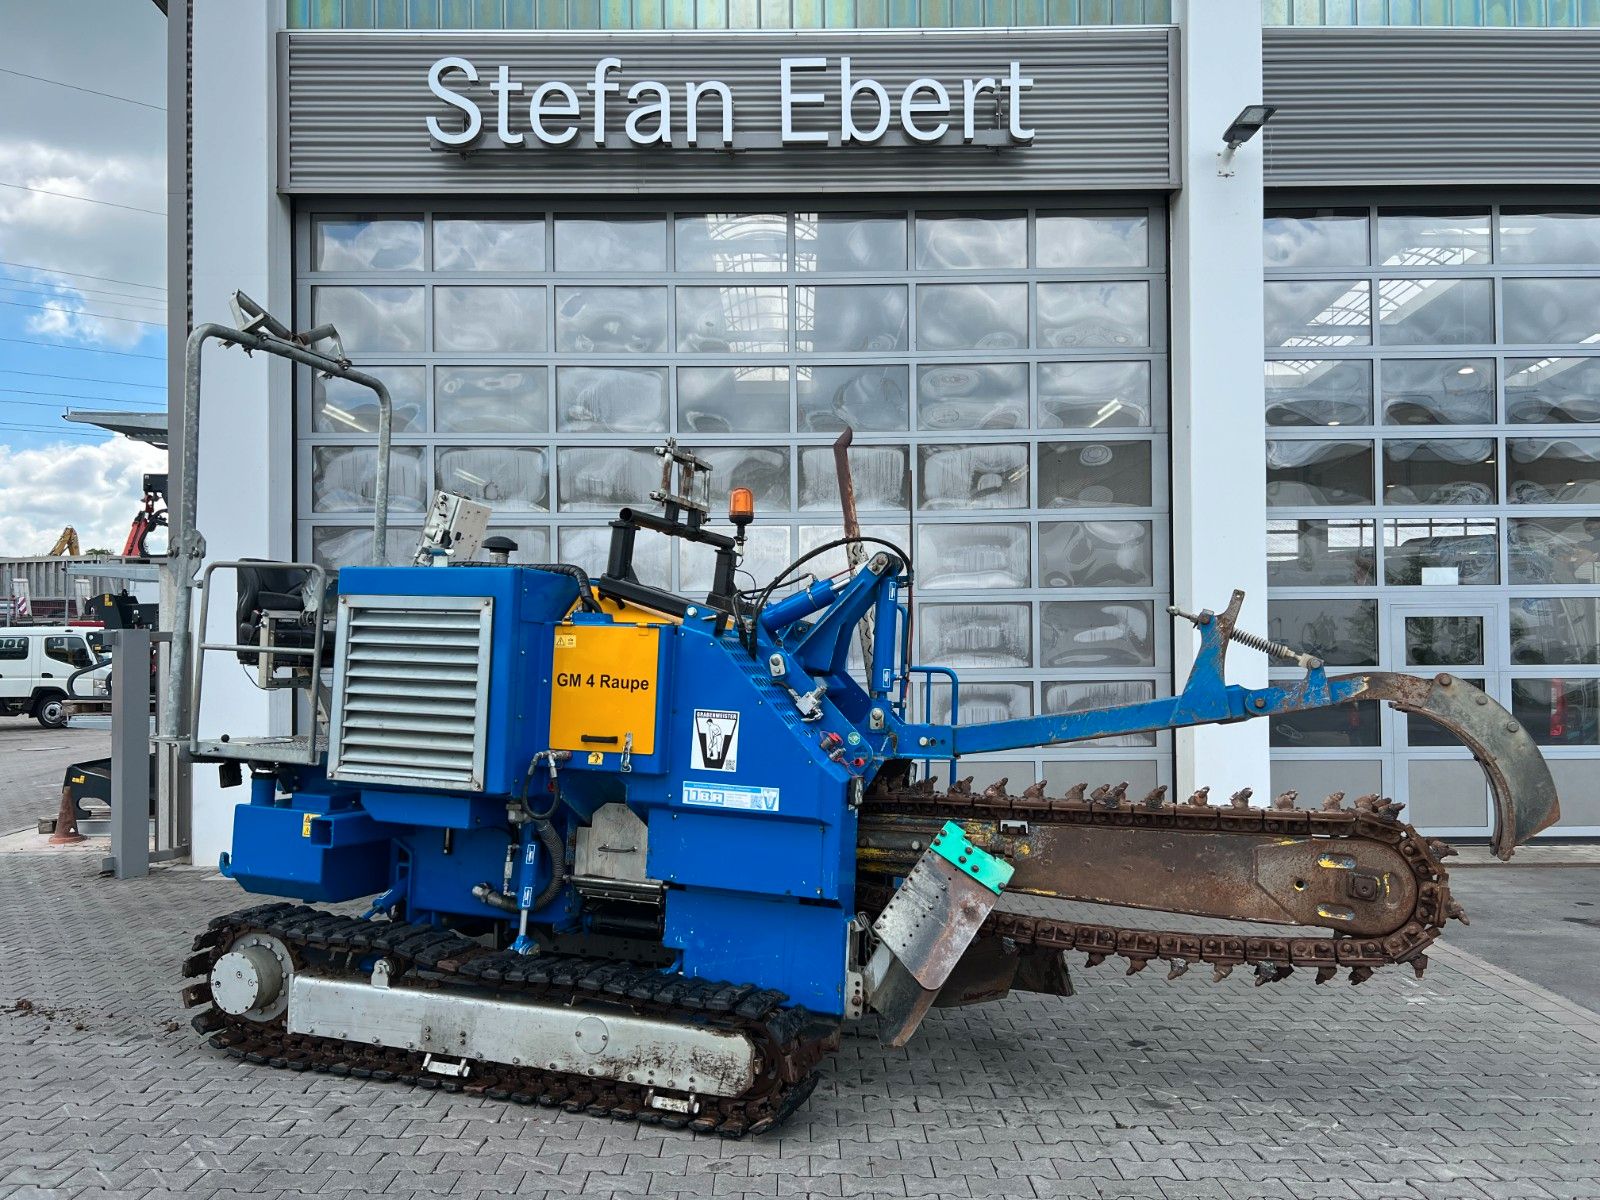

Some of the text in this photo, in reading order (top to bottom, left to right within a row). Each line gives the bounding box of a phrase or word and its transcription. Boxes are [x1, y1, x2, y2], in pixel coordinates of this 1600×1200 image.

[425, 56, 1035, 148] Stefan Ebert
[557, 673, 650, 693] GM 4 Raupe
